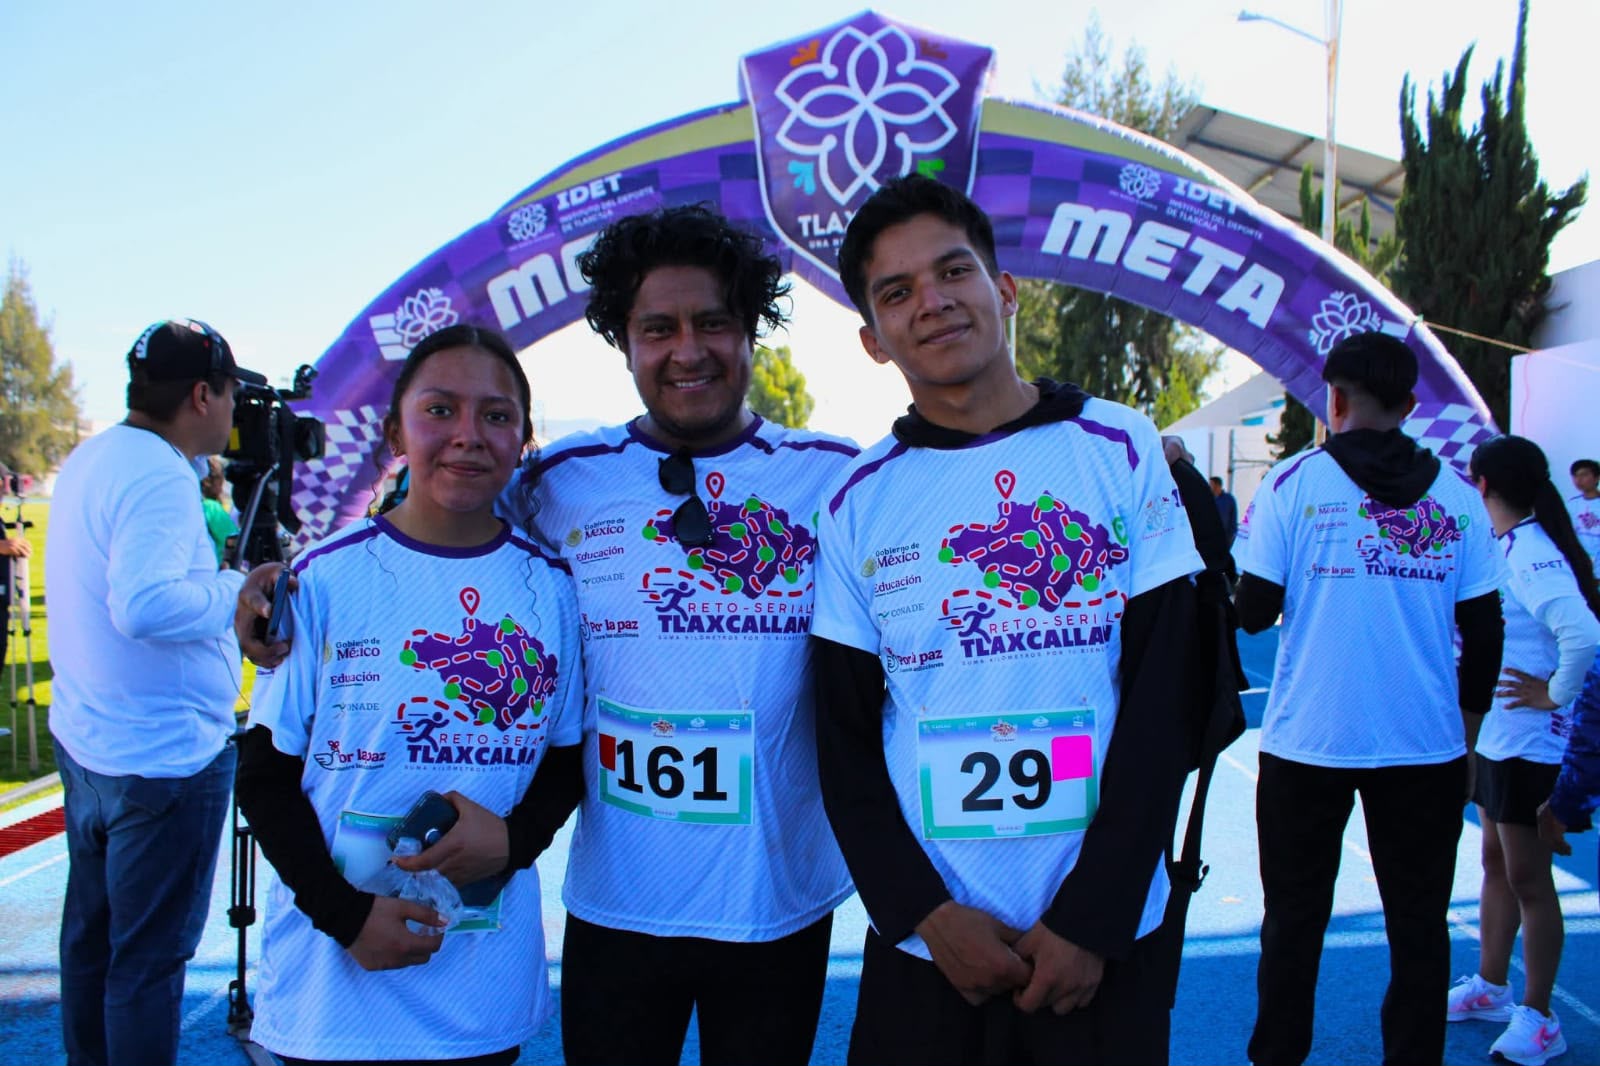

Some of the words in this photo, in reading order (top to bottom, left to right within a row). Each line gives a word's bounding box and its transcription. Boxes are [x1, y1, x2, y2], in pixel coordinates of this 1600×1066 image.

[556, 172, 622, 211] IDET
[1173, 176, 1243, 214] IDET
[1166, 206, 1178, 218] DE
[1169, 199, 1210, 219] INSTITUTO
[1211, 213, 1225, 226] DEL
[1227, 220, 1263, 241] DEPORTE
[1041, 202, 1285, 330] META
[576, 546, 624, 561] Educación
[911, 541, 920, 550] de
[878, 550, 920, 569] México
[1341, 567, 1355, 577] paz
[891, 602, 925, 618] CONADE
[589, 622, 603, 633] Por
[604, 618, 615, 631] la
[617, 620, 639, 633] paz
[658, 615, 809, 634] TLAXCALLAN
[919, 649, 943, 665] paz
[356, 748, 367, 761] la
[617, 740, 727, 801] 161
[960, 749, 1051, 812] 29
